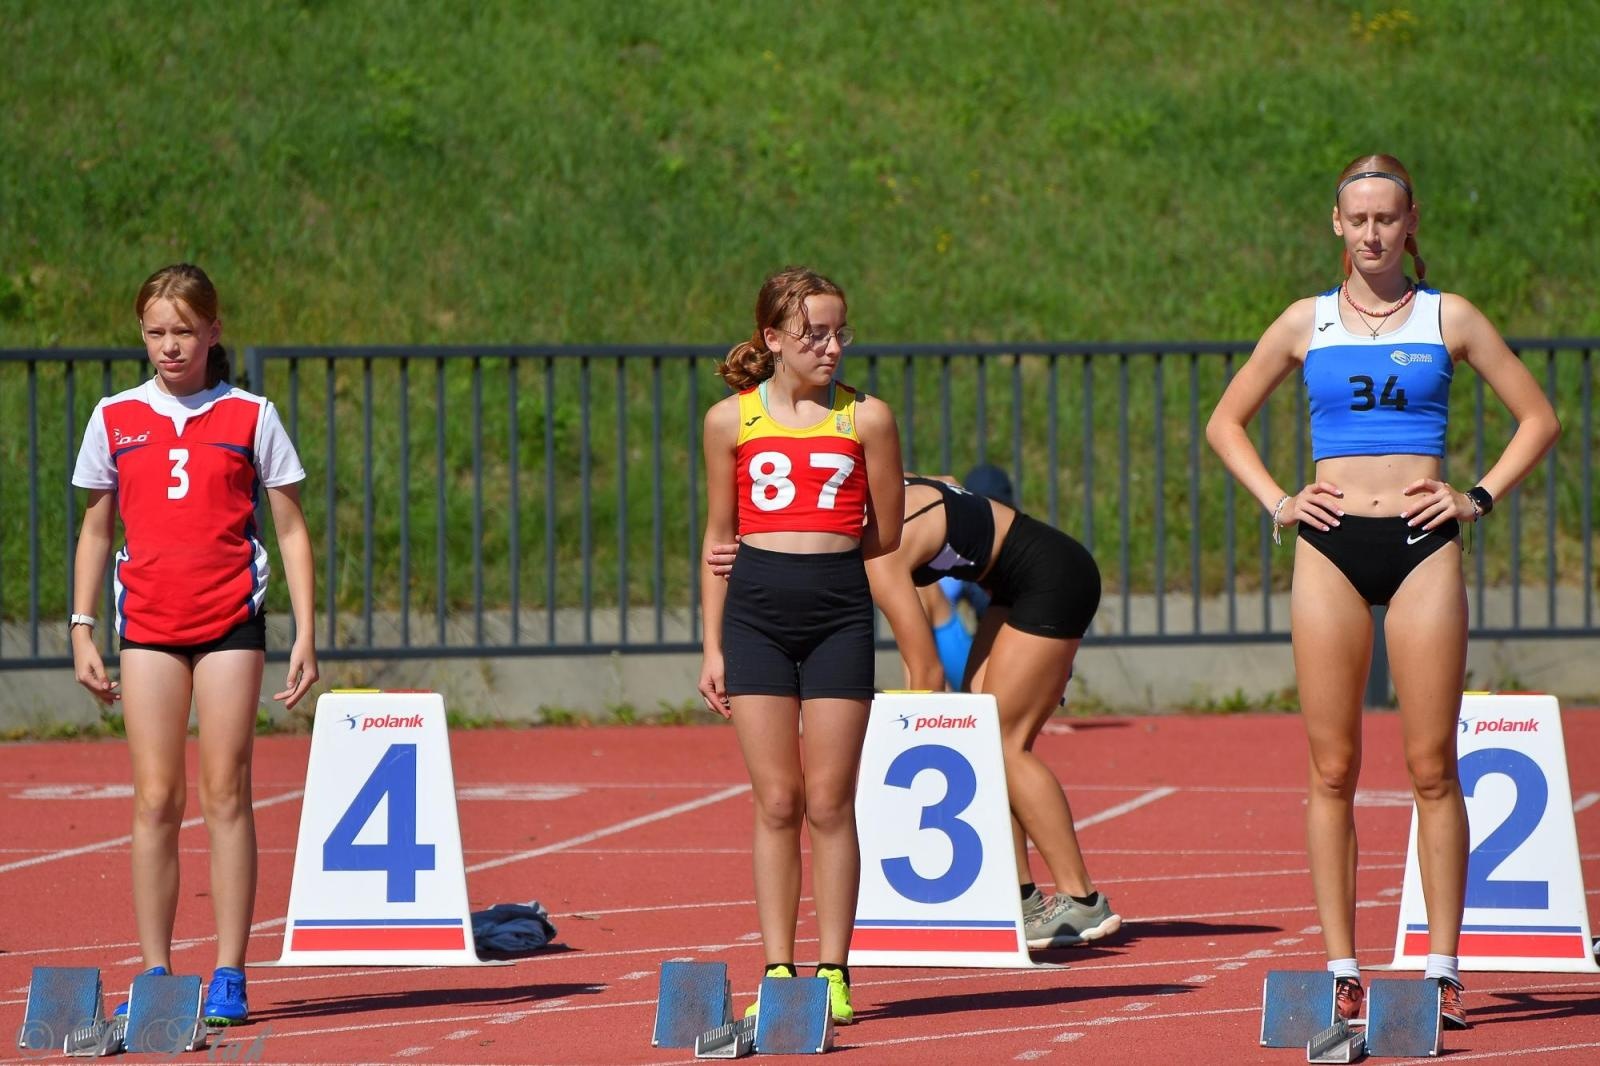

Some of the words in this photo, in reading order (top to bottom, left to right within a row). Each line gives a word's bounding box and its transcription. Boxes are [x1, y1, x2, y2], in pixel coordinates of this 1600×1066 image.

[1349, 375, 1409, 411] 34
[167, 448, 190, 500] 3
[748, 451, 855, 512] 87
[362, 714, 424, 732] polanik
[915, 714, 977, 732] polanik
[1475, 717, 1539, 735] polanik
[322, 743, 436, 903] 4
[880, 743, 984, 904] 3
[1457, 747, 1549, 910] 2
